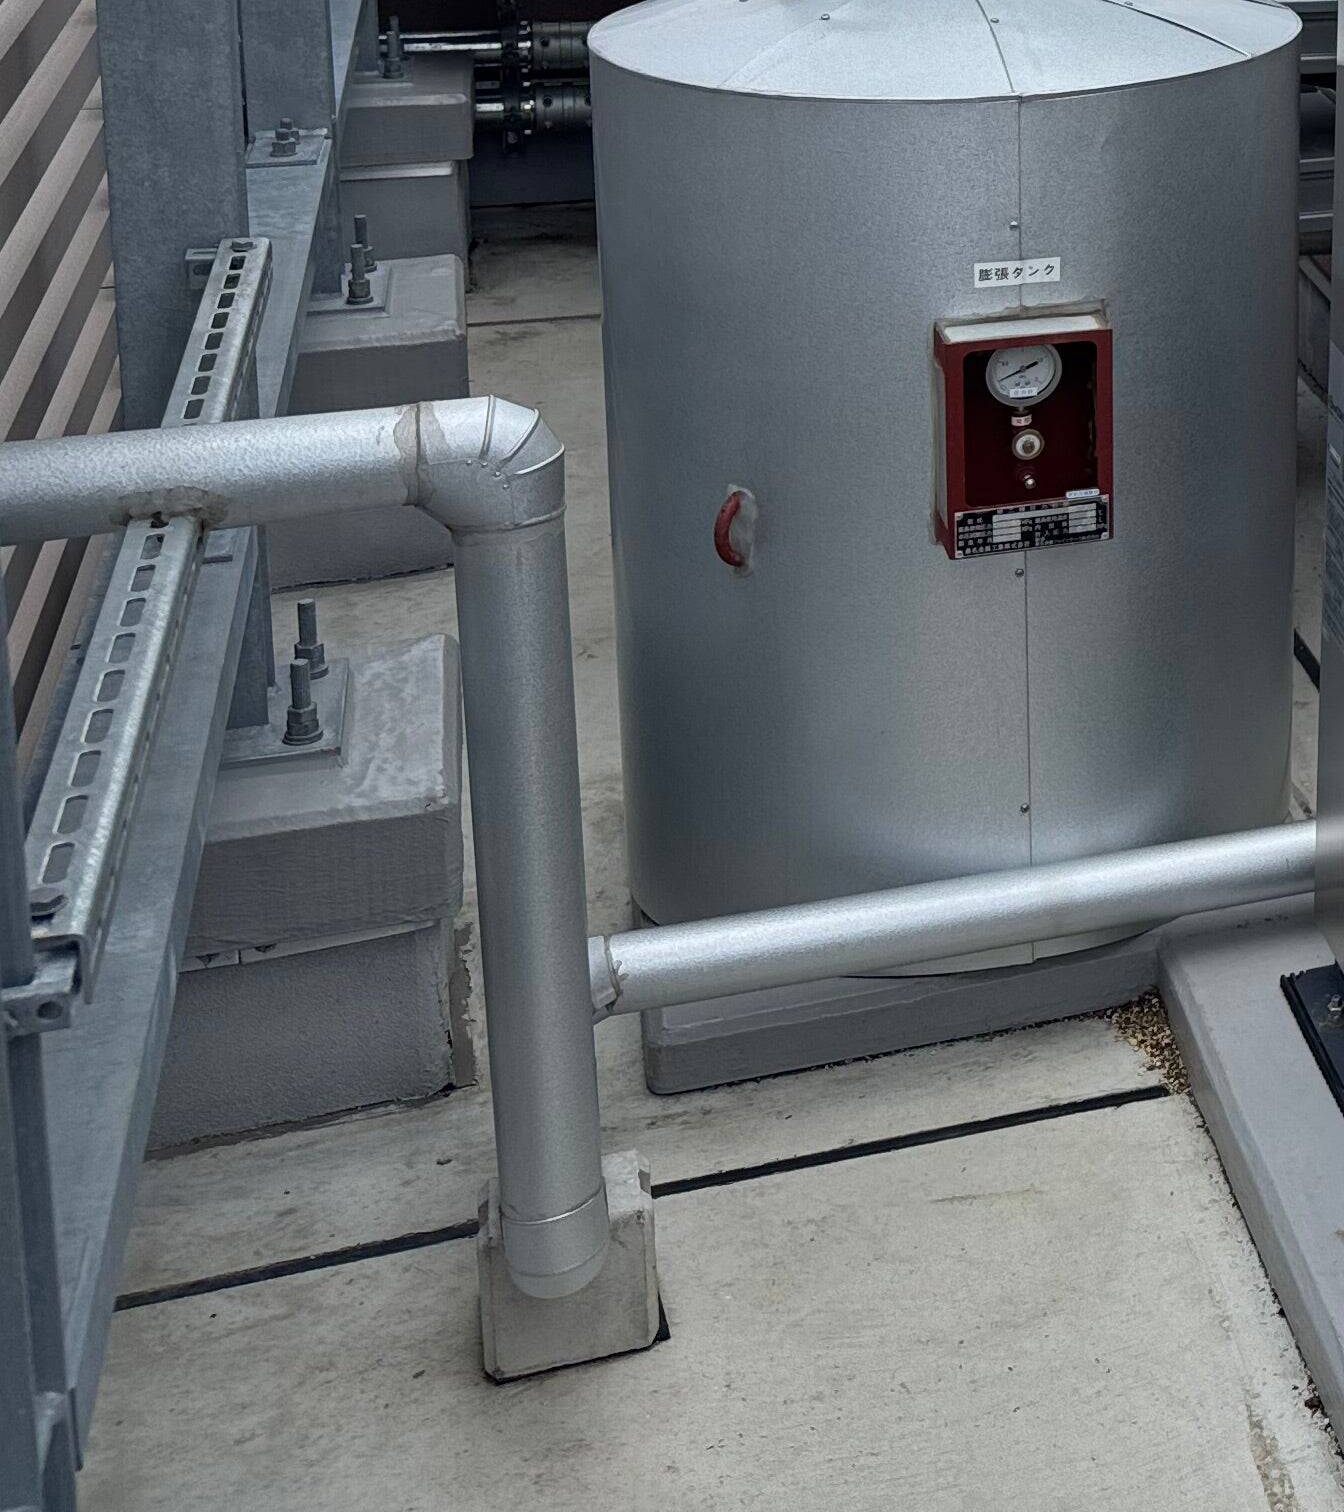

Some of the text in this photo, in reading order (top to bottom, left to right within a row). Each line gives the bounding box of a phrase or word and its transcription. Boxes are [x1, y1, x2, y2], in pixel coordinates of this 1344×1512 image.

[978, 263, 1055, 282] 膨張タンク
